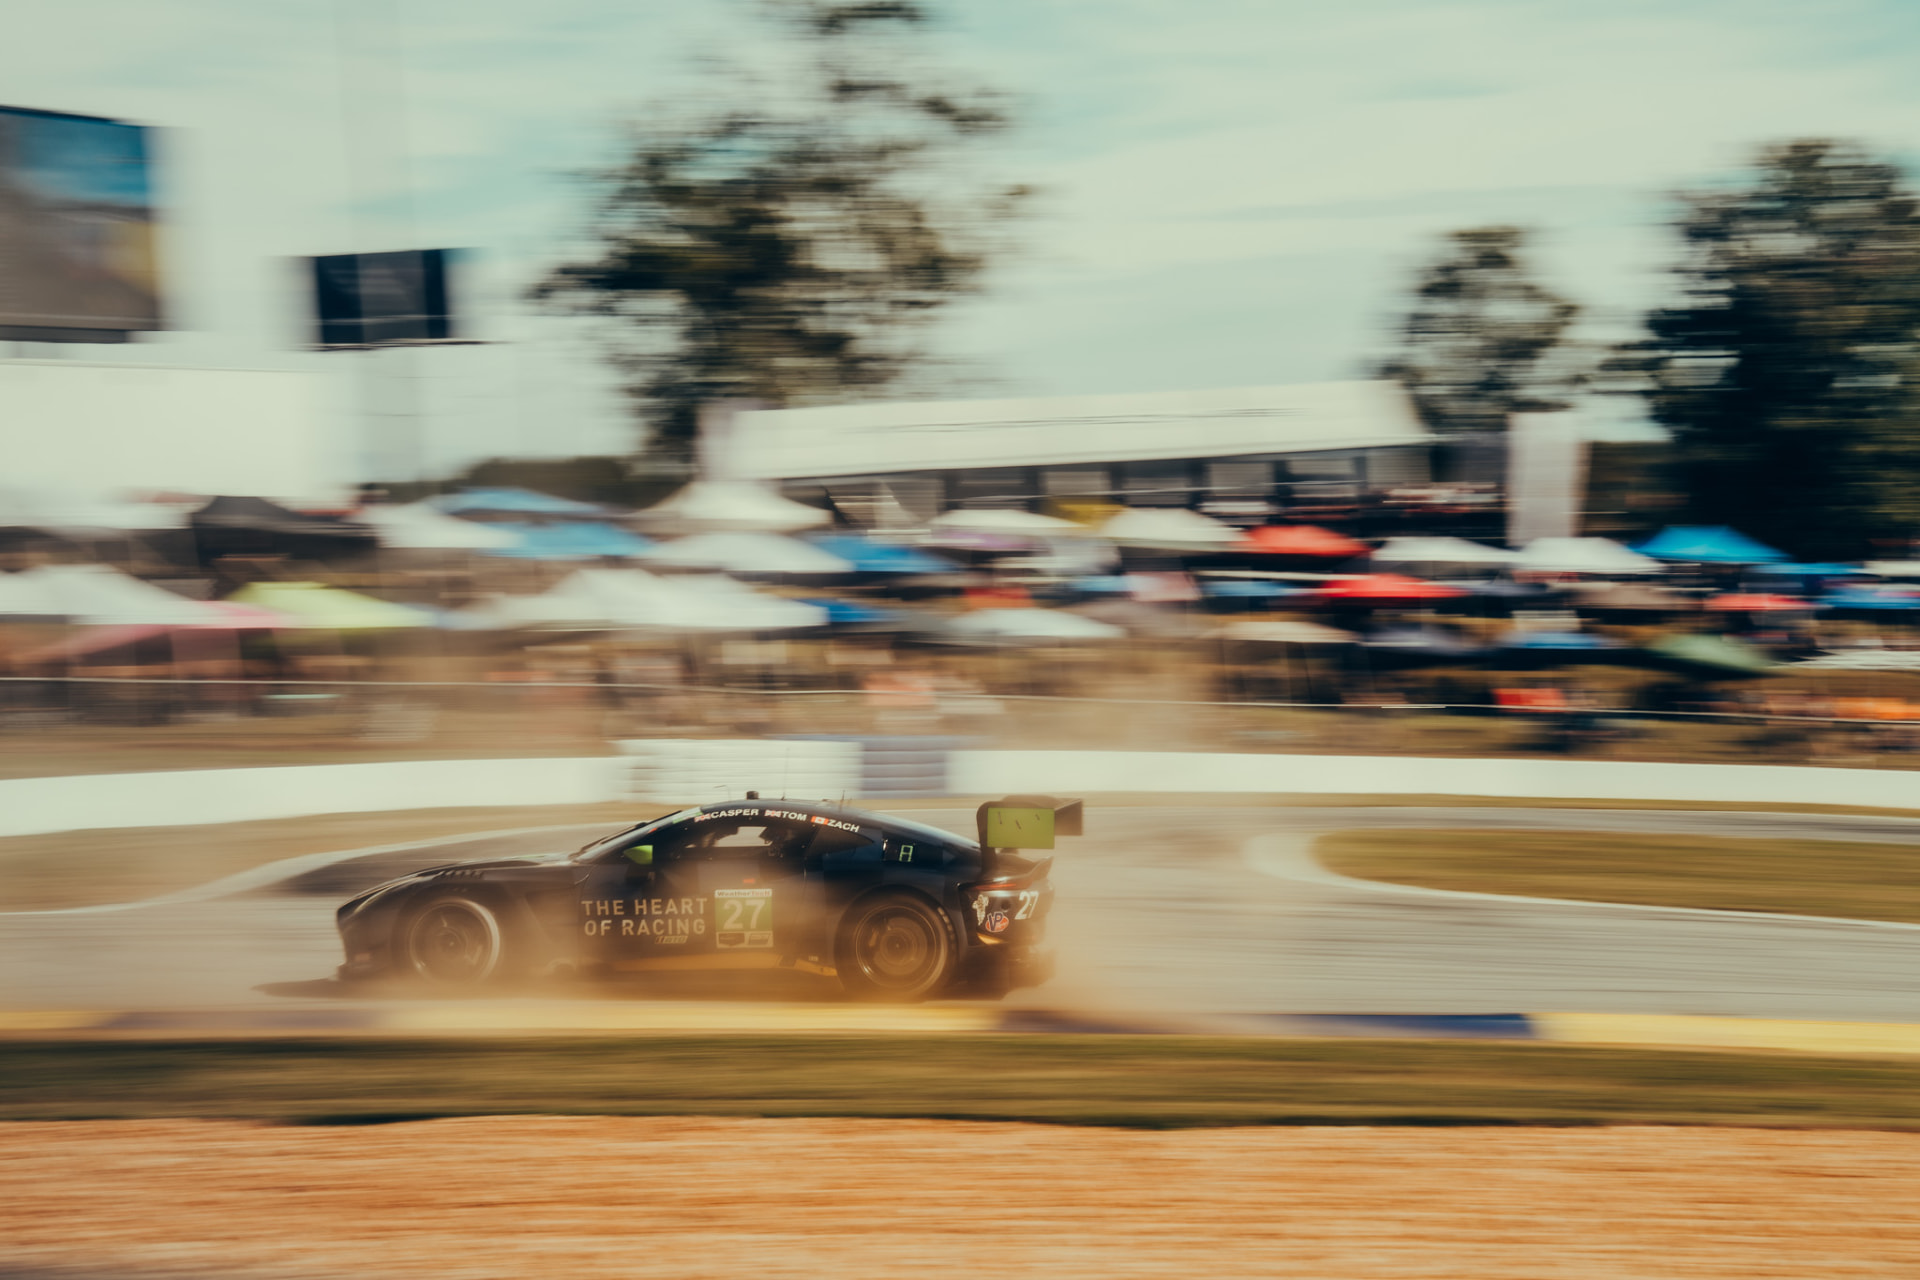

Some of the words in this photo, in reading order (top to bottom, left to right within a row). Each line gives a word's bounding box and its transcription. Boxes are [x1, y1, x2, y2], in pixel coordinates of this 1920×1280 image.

[711, 808, 759, 819] CASPER
[782, 811, 807, 821] TOM
[827, 818, 860, 833] ZACH
[581, 900, 625, 916] THE
[635, 898, 707, 915] HEART
[723, 899, 766, 930] 27
[1014, 890, 1039, 920] 27
[584, 919, 612, 936] OF
[622, 918, 706, 936] RACING
[987, 911, 1004, 932] VP
